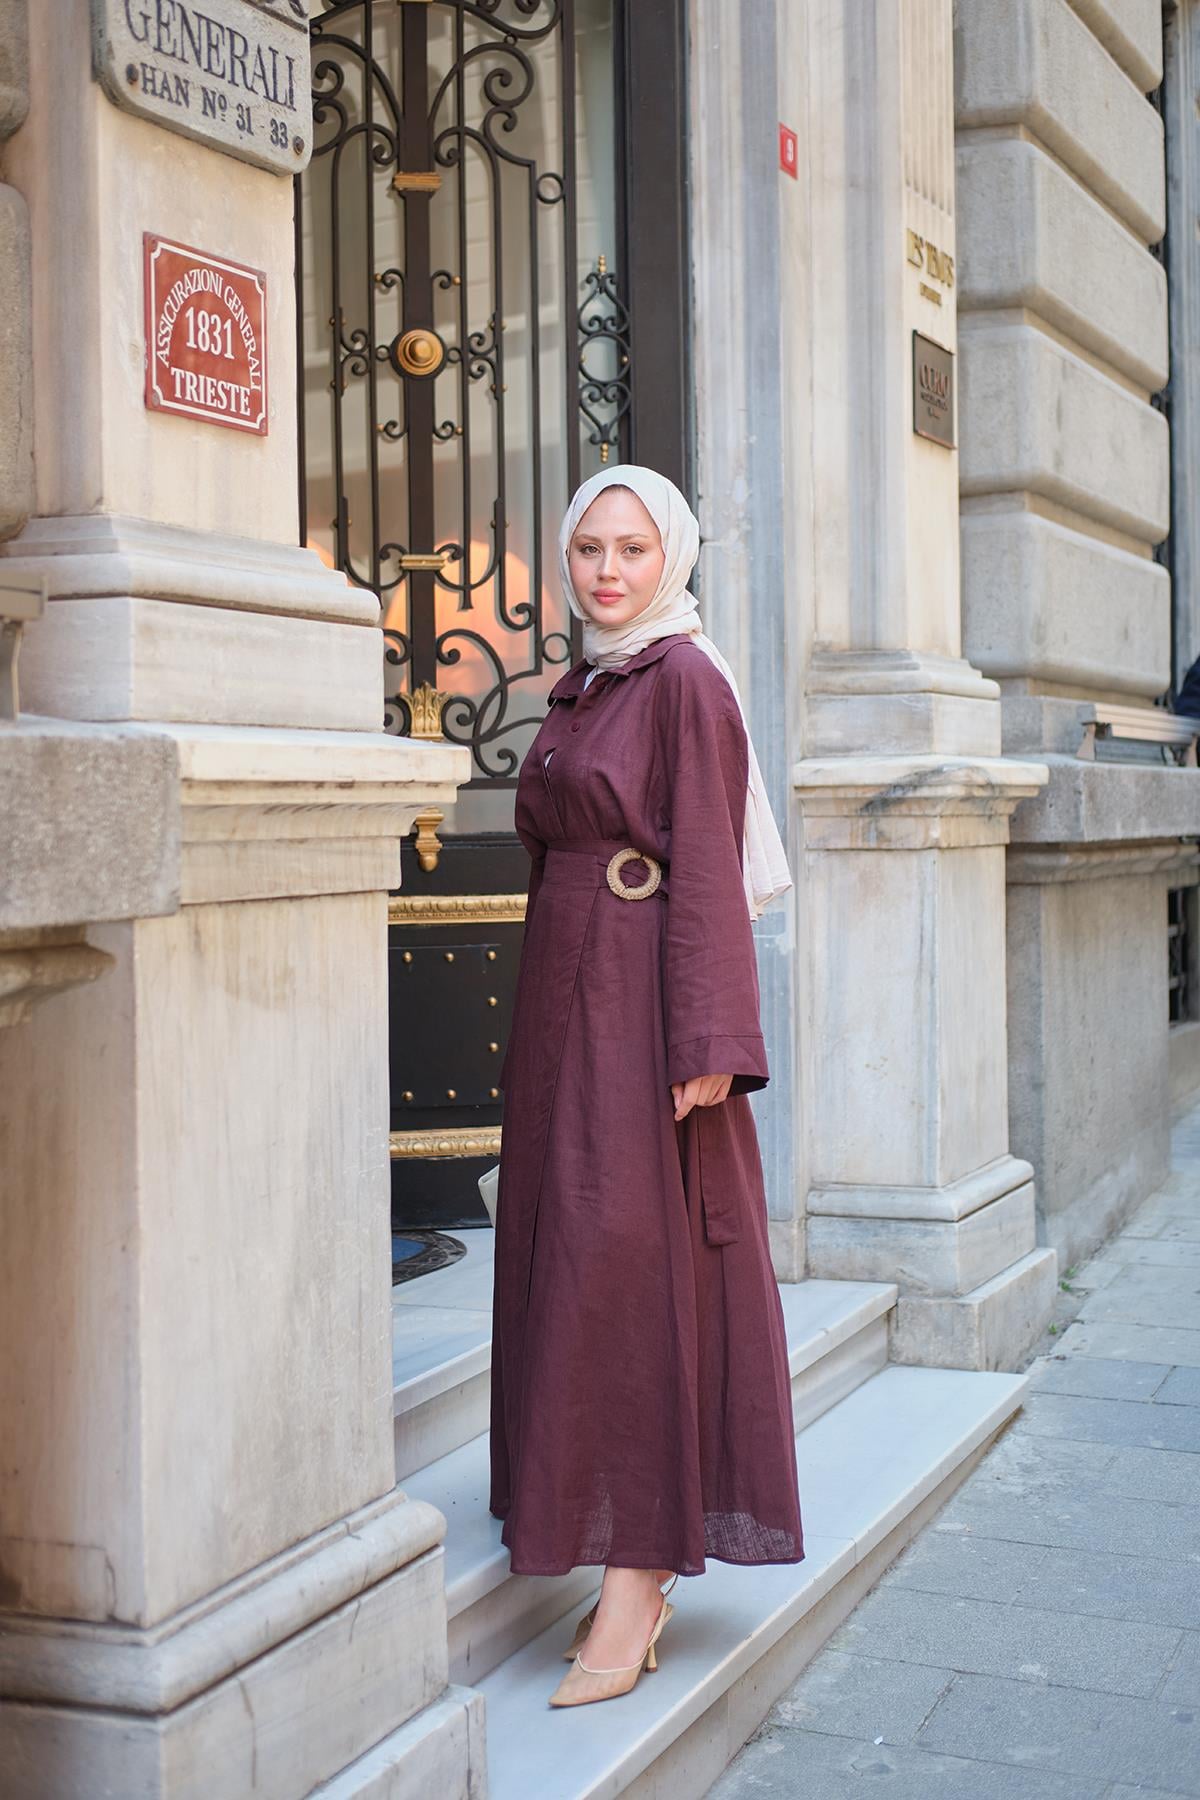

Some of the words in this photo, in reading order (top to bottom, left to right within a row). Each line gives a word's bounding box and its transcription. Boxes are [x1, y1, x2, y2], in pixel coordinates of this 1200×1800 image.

[125, 0, 297, 112] GENERALI
[140, 63, 189, 108] HAN
[235, 103, 254, 136] 31
[270, 118, 288, 149] 33
[157, 268, 224, 368] ASSICURAZIONI
[224, 285, 262, 392] GENERALI
[185, 306, 235, 360] 1831
[170, 366, 251, 417] TRIESTE
